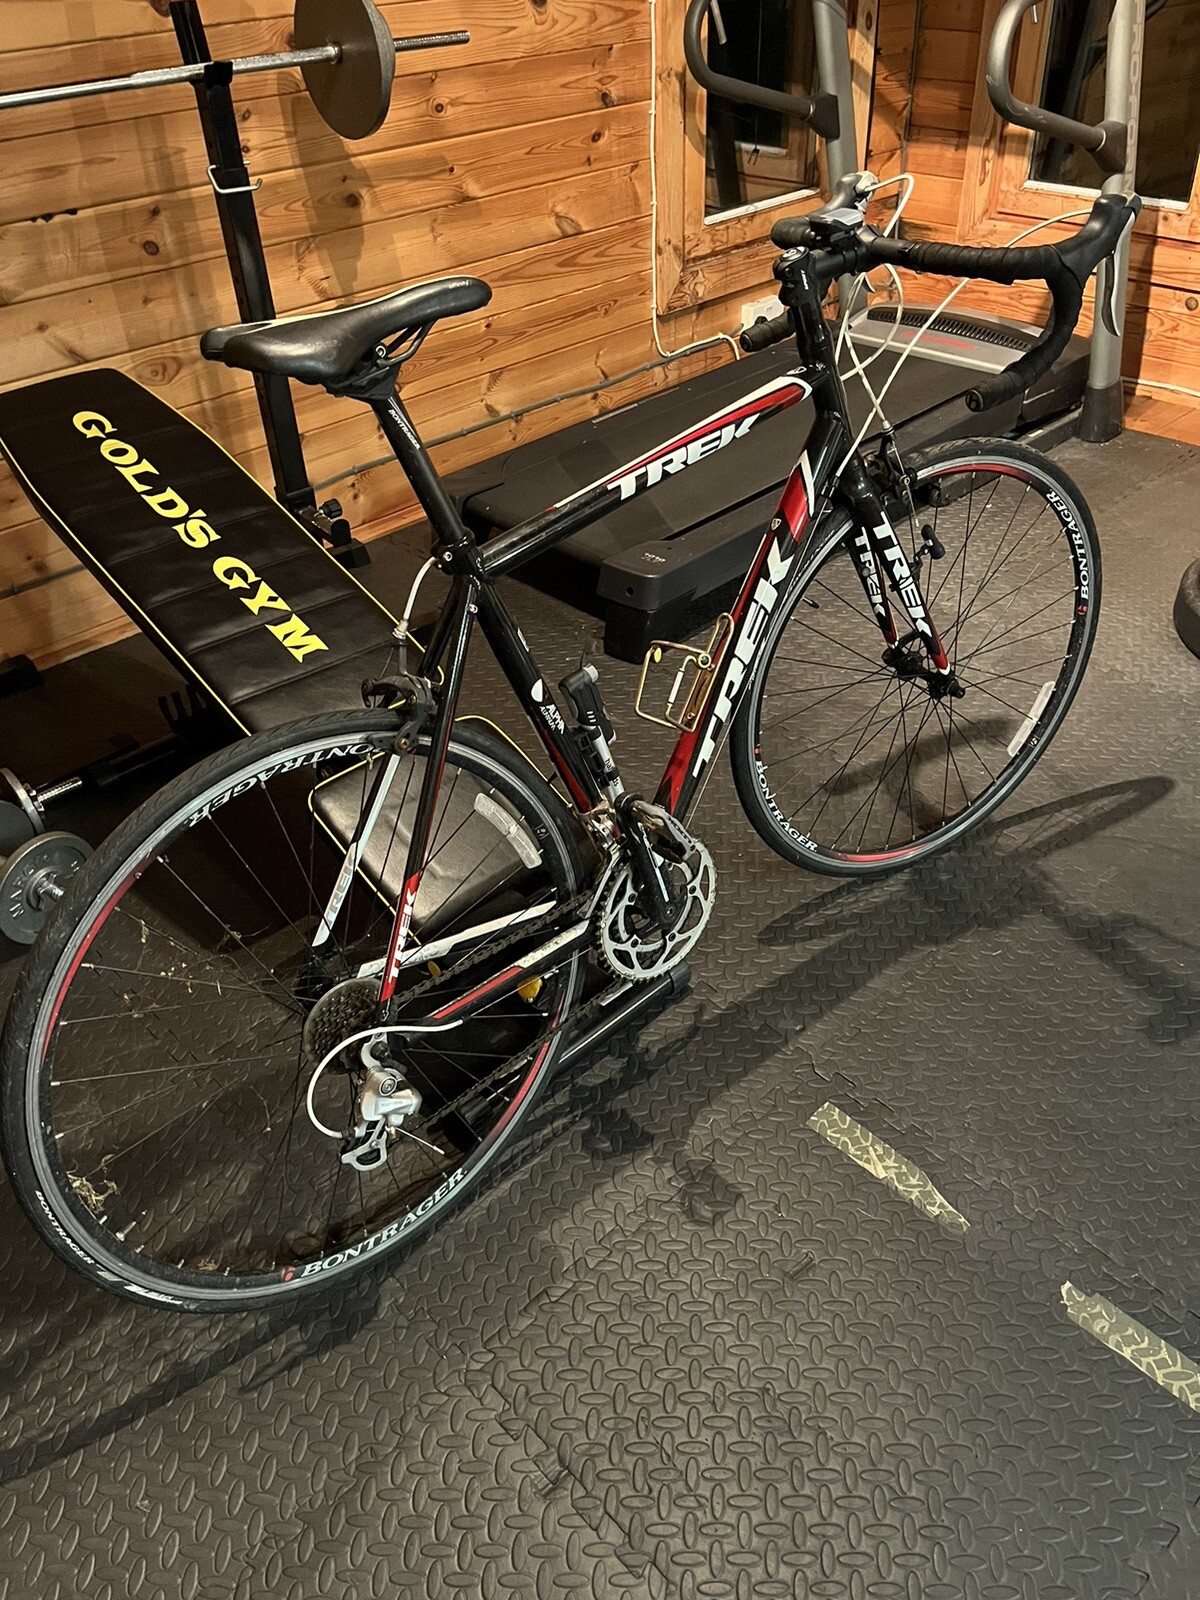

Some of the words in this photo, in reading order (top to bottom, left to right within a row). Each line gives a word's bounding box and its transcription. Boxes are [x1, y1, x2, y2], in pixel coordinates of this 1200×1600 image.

[388, 408, 421, 450] BONTRAGER
[606, 412, 761, 501] TREK
[72, 411, 222, 549] GOLD'S
[212, 556, 330, 664] GYM
[855, 526, 887, 617] TREK
[872, 510, 933, 638] TREK
[1046, 488, 1089, 600] BONTRAGER
[692, 536, 796, 778] TREK
[545, 703, 565, 735] ALPHA
[755, 760, 818, 853] BONTRAGER
[388, 887, 417, 984] TREK
[35, 1190, 96, 1265] BONTRAGER
[301, 1167, 469, 1278] BONTRAGER
